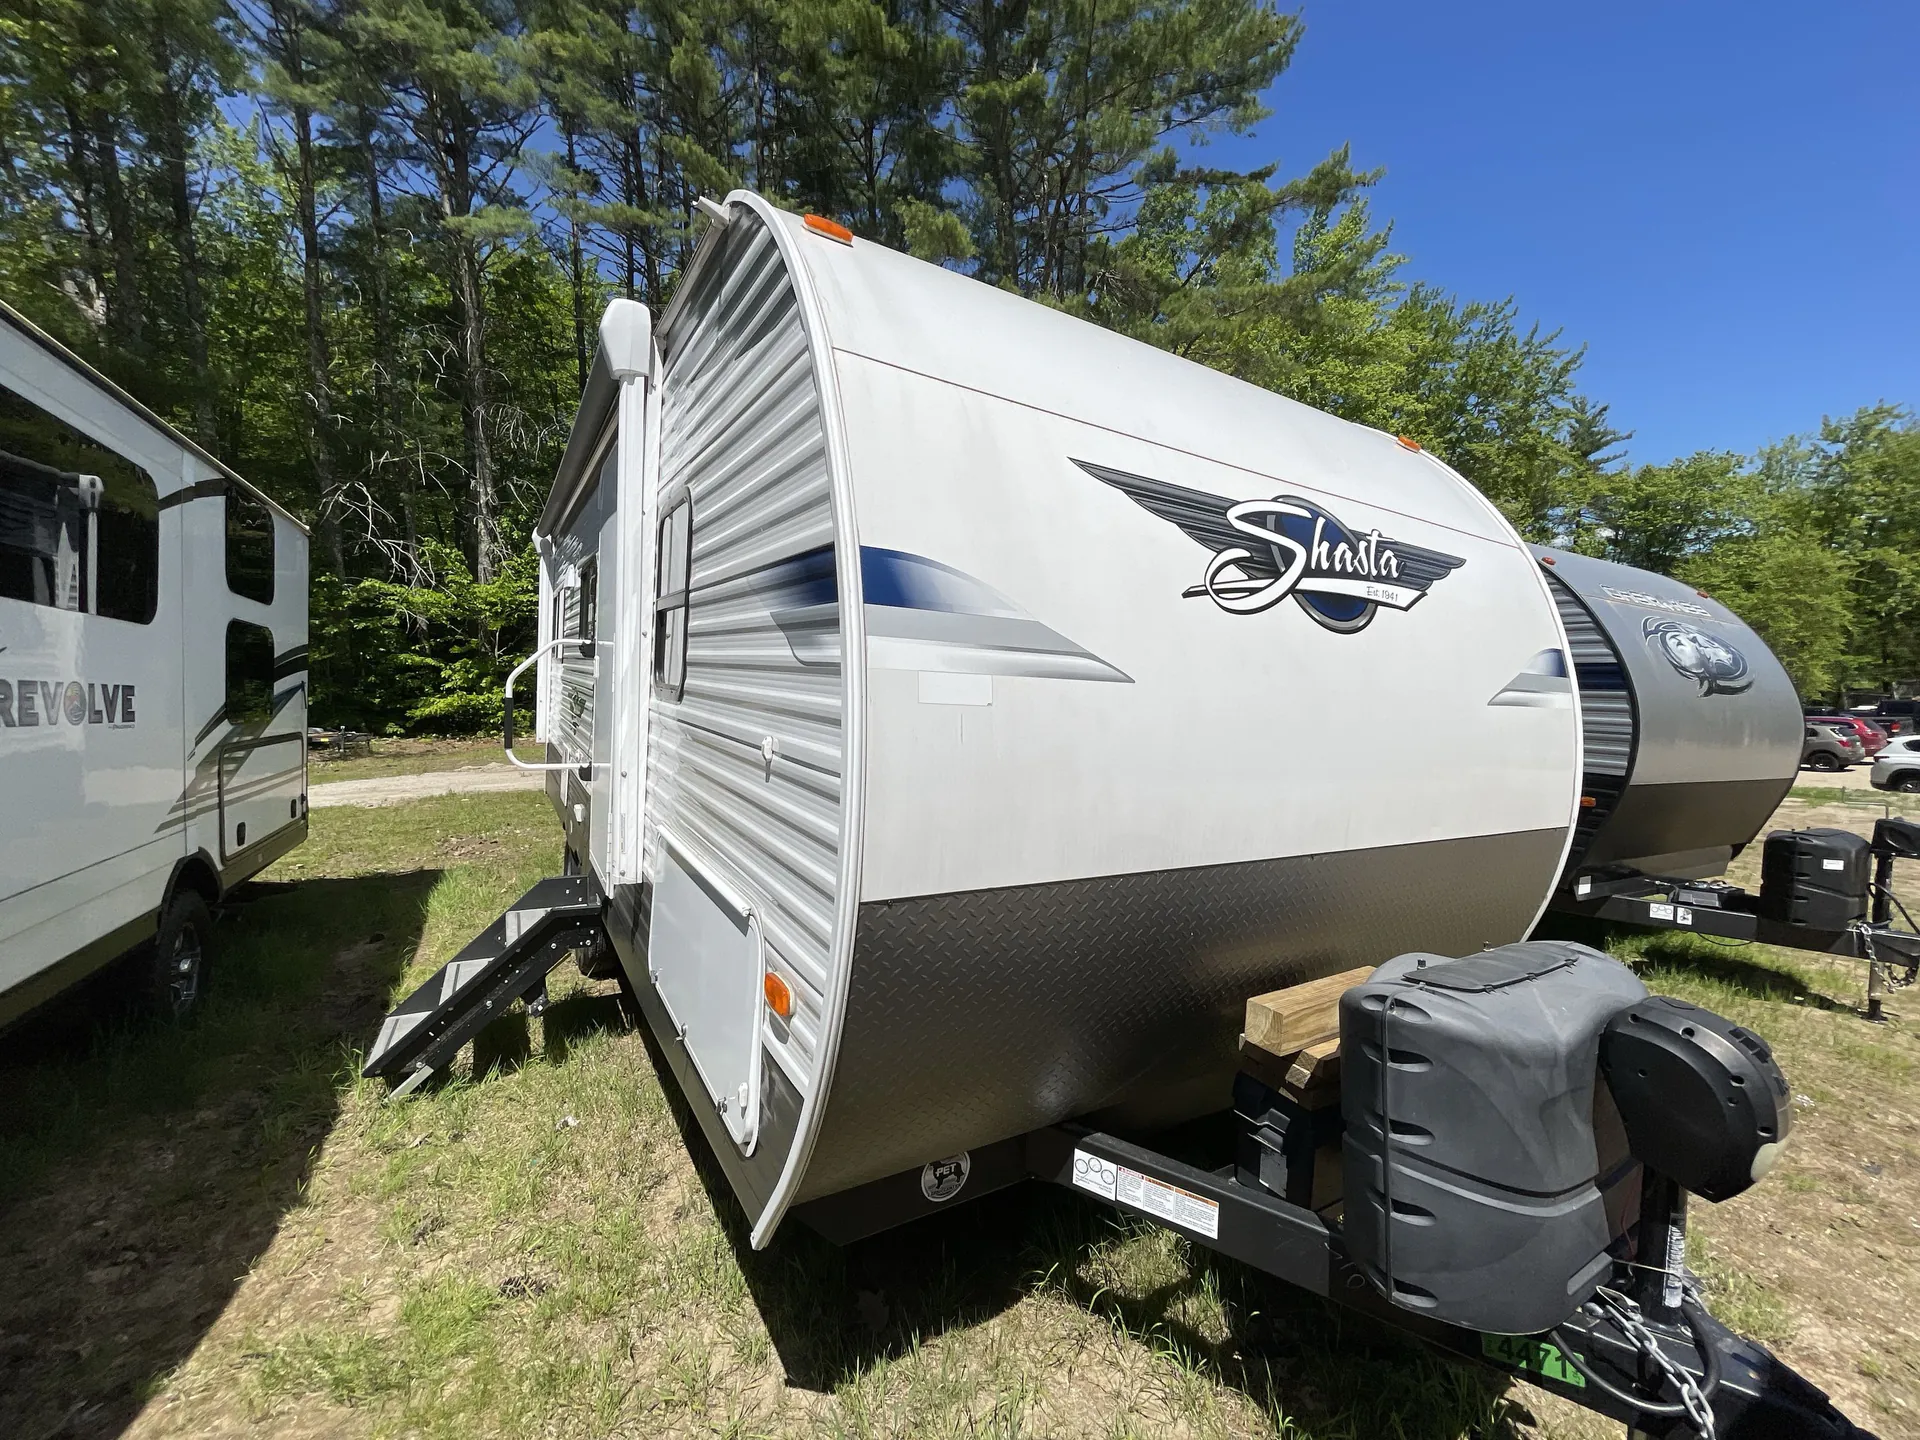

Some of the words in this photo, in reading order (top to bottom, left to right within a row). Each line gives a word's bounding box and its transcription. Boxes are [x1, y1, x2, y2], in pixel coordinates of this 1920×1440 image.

[1204, 499, 1403, 614] Shasta
[1381, 589, 1399, 602] 1941
[0, 678, 136, 728] REVOLVE
[935, 1163, 957, 1177] PET
[1498, 1336, 1568, 1379] 4471
